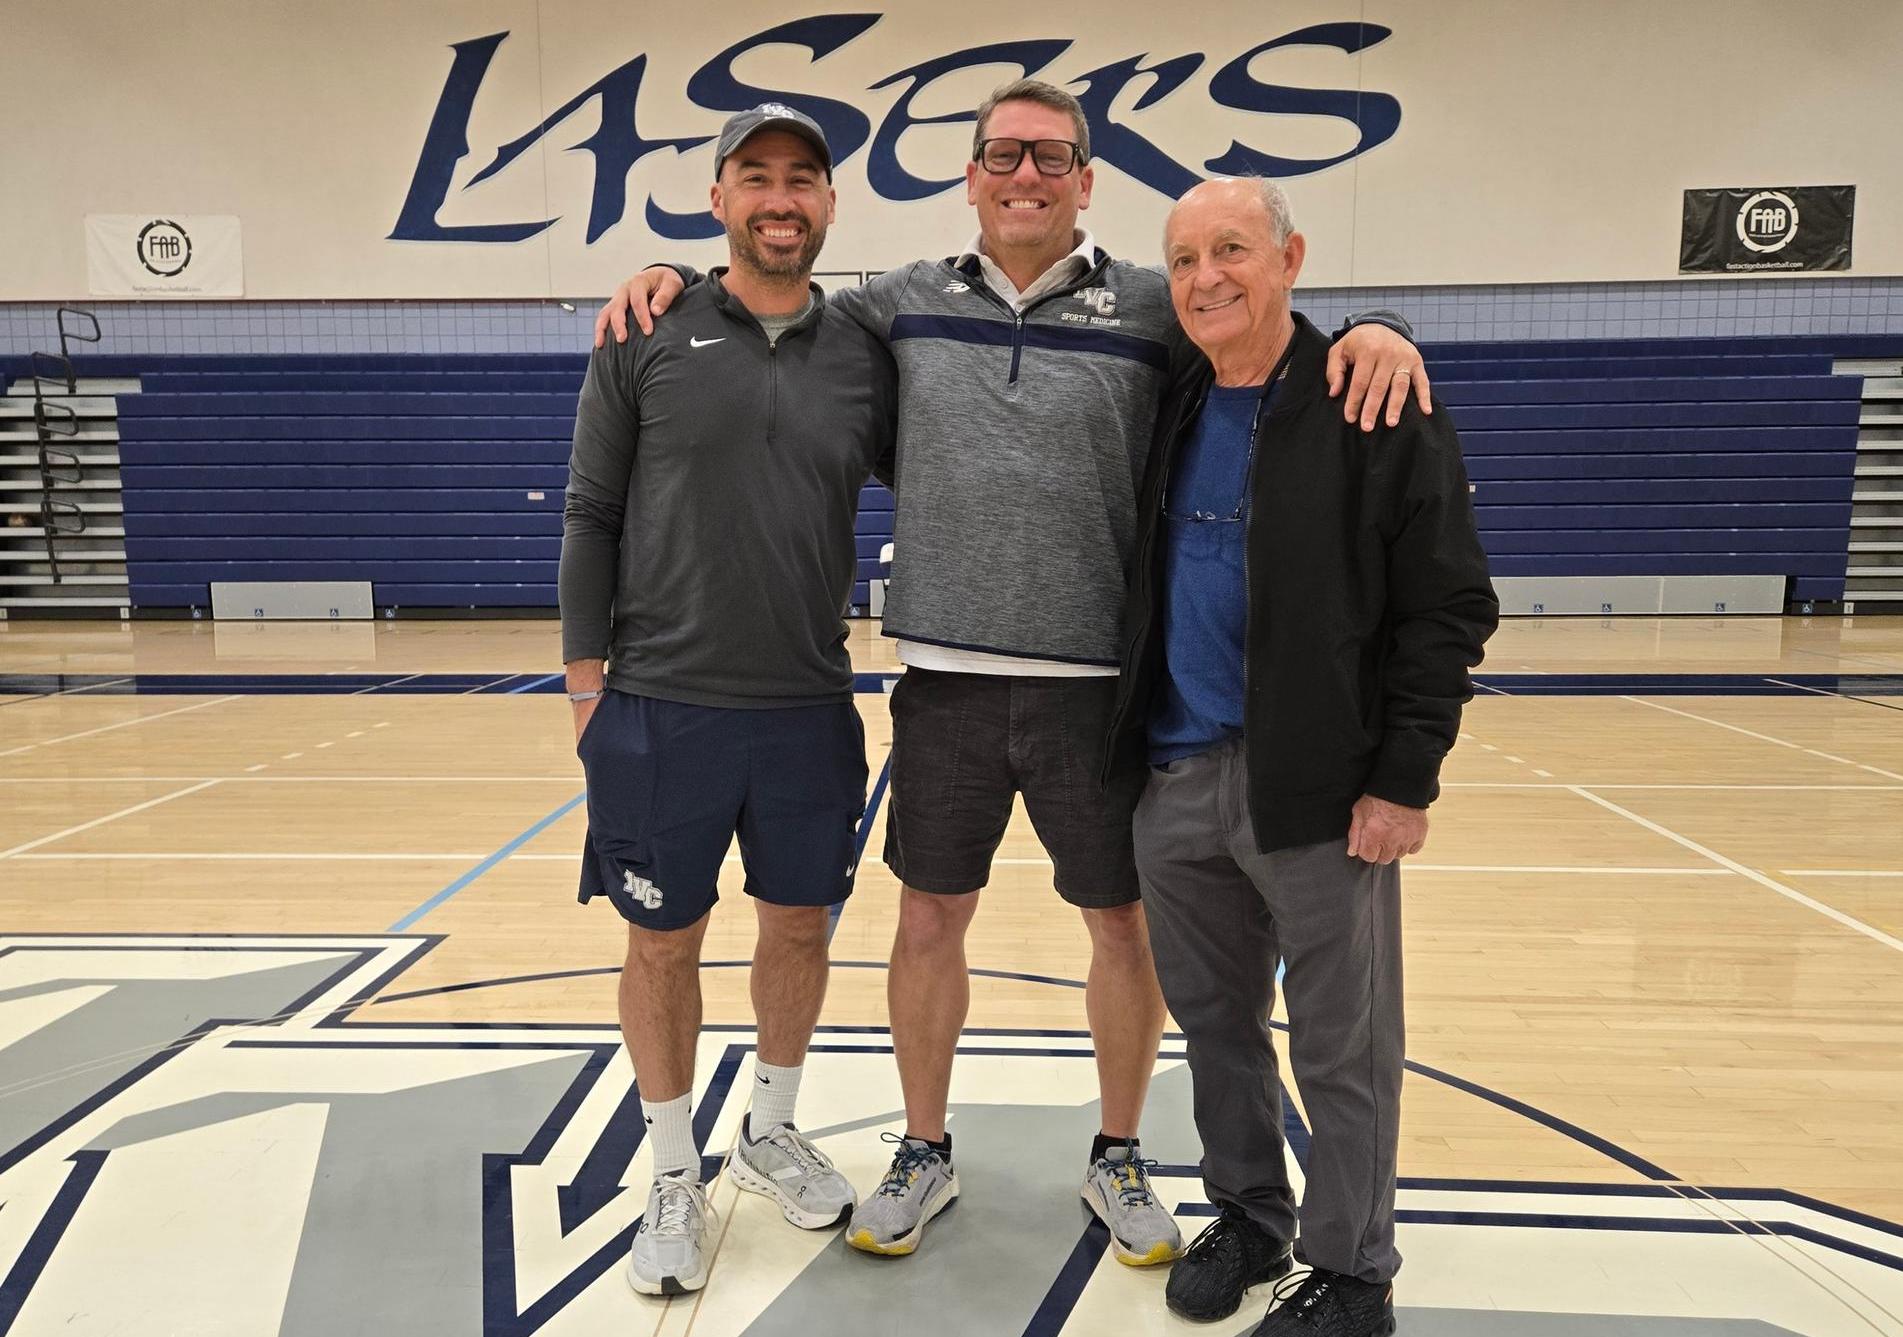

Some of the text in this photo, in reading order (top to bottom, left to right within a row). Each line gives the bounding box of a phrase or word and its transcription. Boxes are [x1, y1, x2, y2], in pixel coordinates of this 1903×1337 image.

[1750, 208, 1786, 233] FAB
[149, 236, 180, 258] FAB
[1061, 312, 1121, 326] SPORTS MEDICINE
